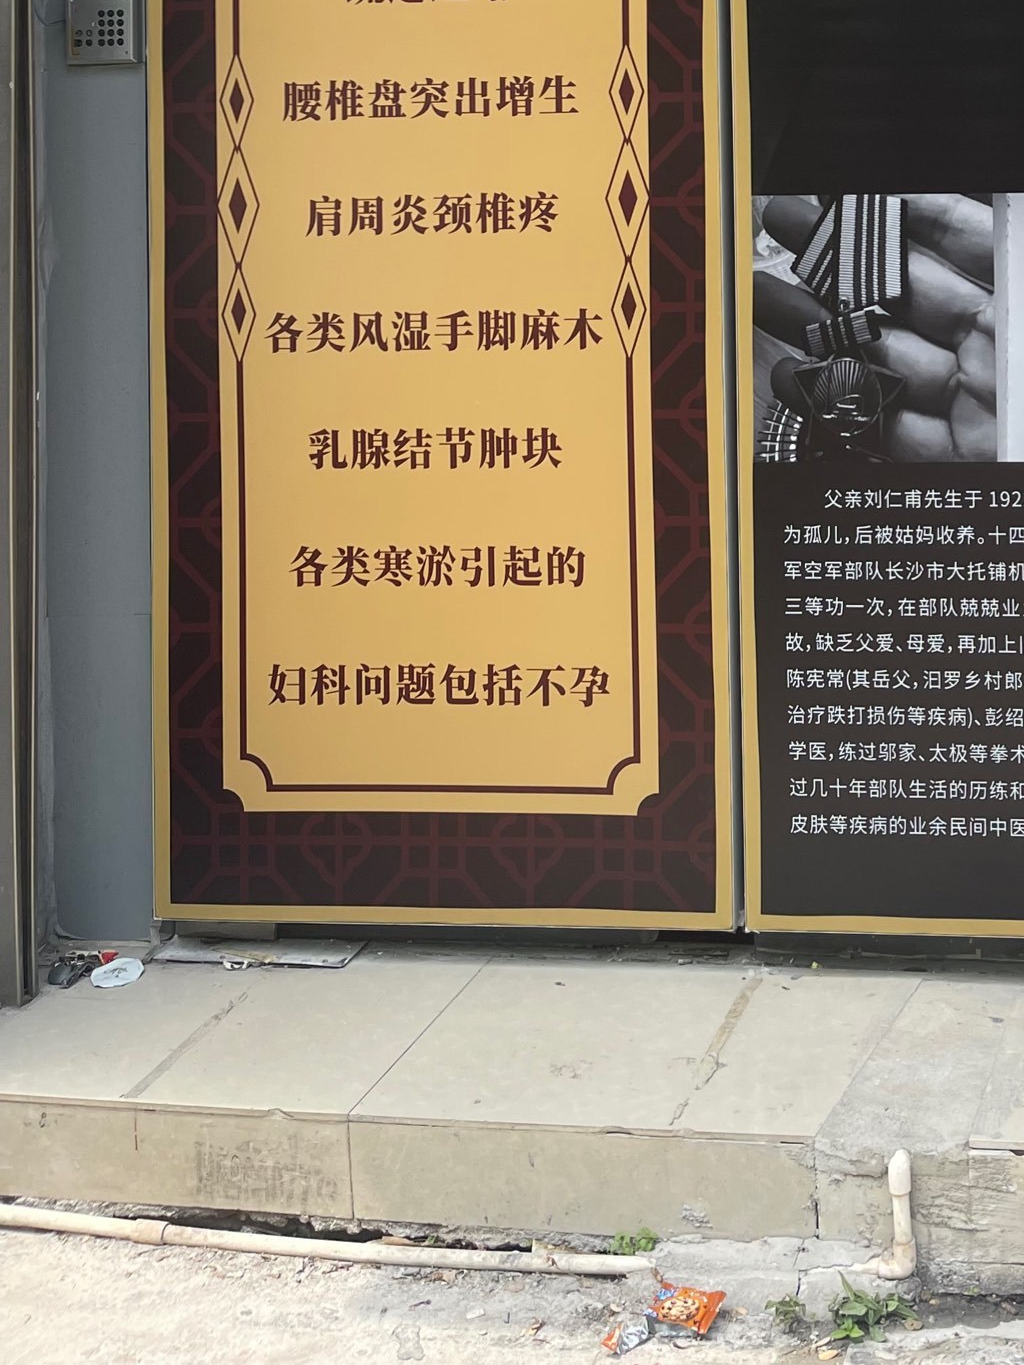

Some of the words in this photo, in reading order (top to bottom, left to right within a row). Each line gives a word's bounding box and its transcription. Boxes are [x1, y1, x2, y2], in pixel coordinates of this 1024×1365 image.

[281, 75, 580, 123] 腰椎盘突出增生
[304, 191, 560, 237] 肩周炎颈椎疼
[264, 309, 604, 354] 各类风湿手脚麻木
[307, 427, 563, 471] 乳腺结节肿块
[288, 545, 587, 588] 各类寒淤引起的
[267, 663, 611, 709] 妇科问题包括不孕
